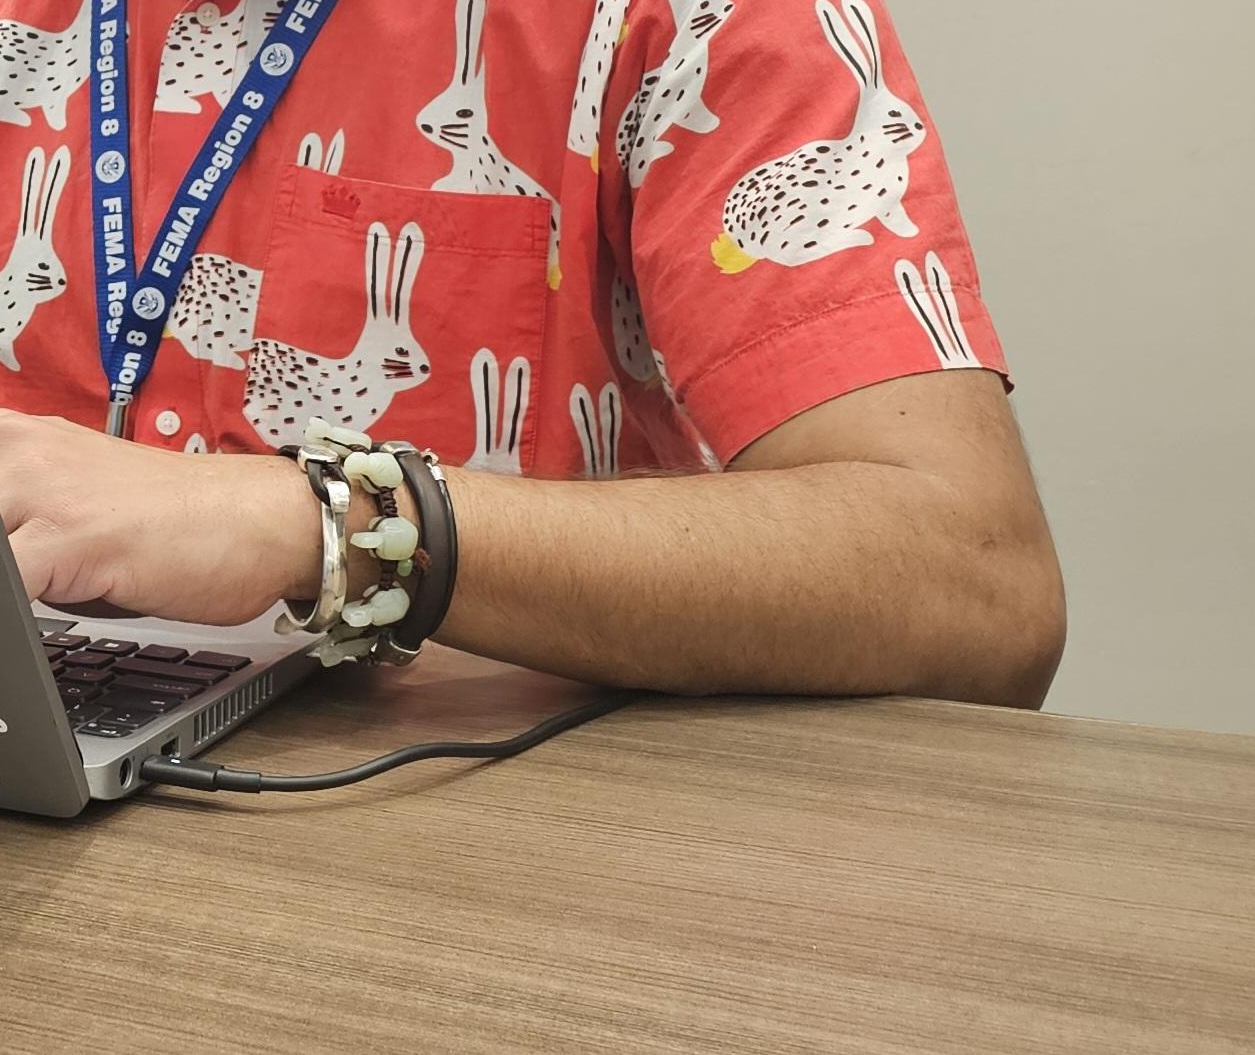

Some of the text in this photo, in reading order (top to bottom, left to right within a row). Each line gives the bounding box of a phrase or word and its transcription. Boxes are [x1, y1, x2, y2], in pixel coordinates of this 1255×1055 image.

[96, 19, 119, 113] Region
[101, 118, 120, 137] 8
[152, 90, 264, 278] FEMA Region 8
[102, 197, 126, 276] FEMA
[126, 330, 147, 347] 8
